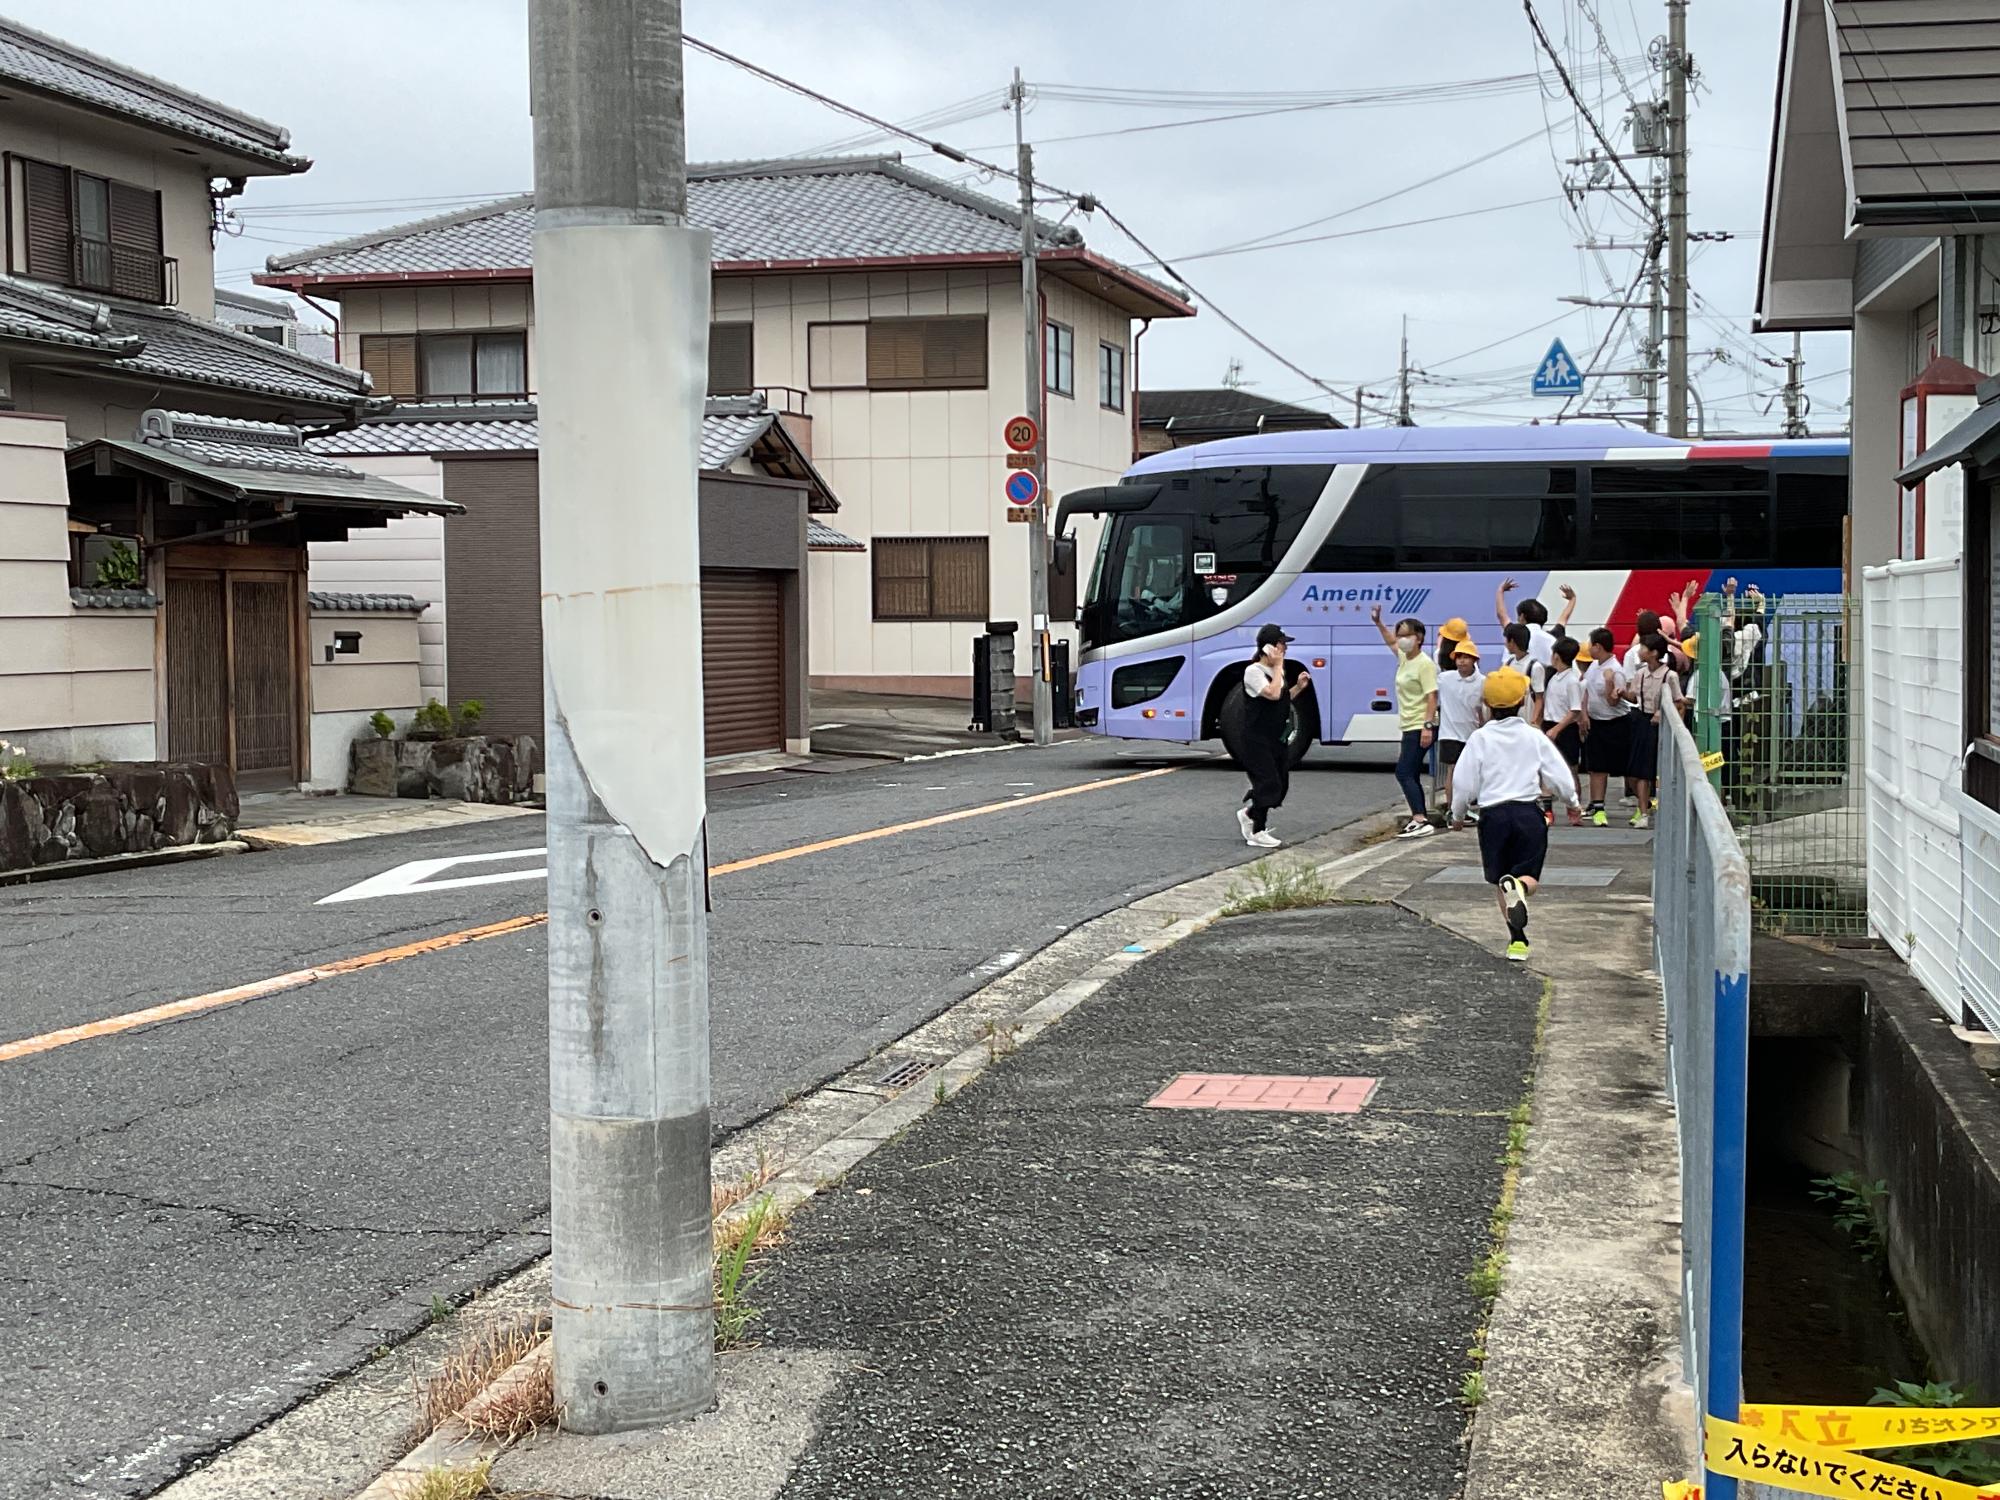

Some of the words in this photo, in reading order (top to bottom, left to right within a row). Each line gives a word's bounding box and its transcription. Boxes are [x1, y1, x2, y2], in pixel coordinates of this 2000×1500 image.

[1012, 426, 1031, 442] 20
[1302, 584, 1410, 613] Amenity
[1724, 1437, 1943, 1500] 入らないでください
